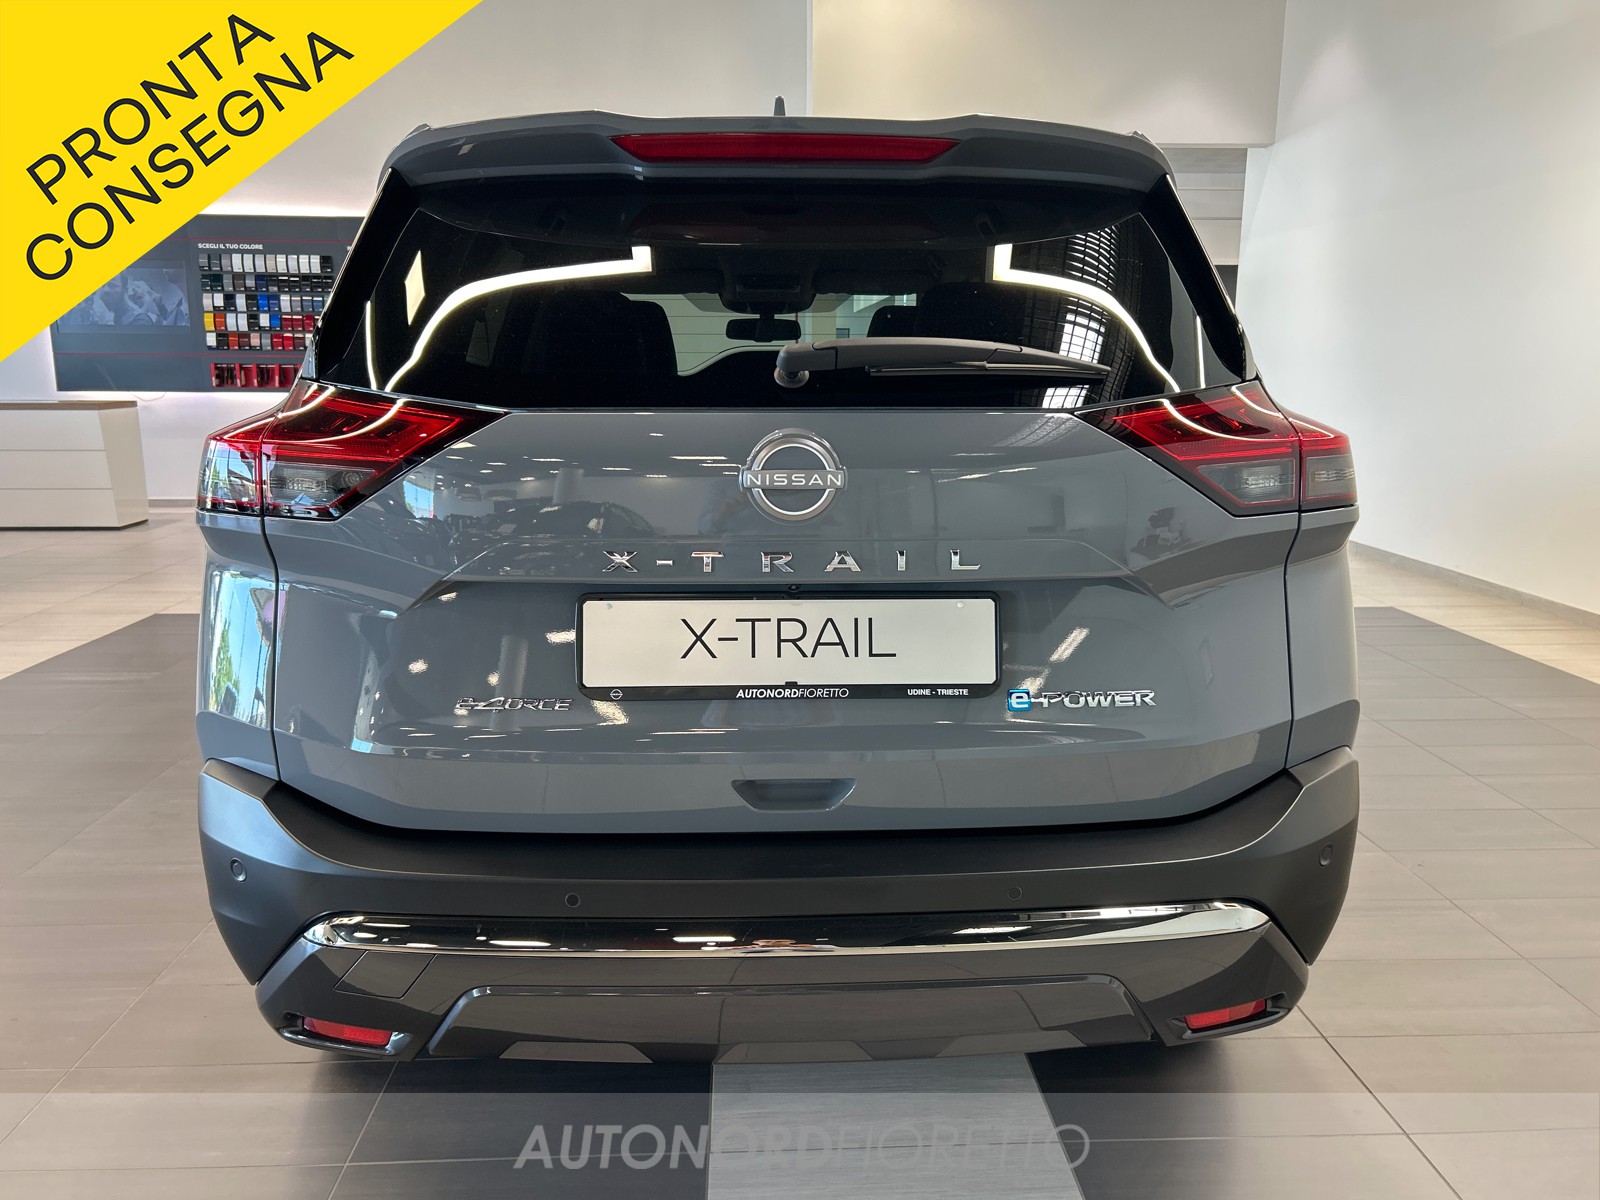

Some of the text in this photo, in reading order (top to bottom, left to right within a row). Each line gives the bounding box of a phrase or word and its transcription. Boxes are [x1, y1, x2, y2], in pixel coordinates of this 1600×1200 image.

[747, 474, 841, 486] NISSAN
[602, 549, 981, 573] X-TRAIL
[680, 617, 896, 659] X-TRAIL
[736, 688, 849, 698] AUTONORDFIORETTO
